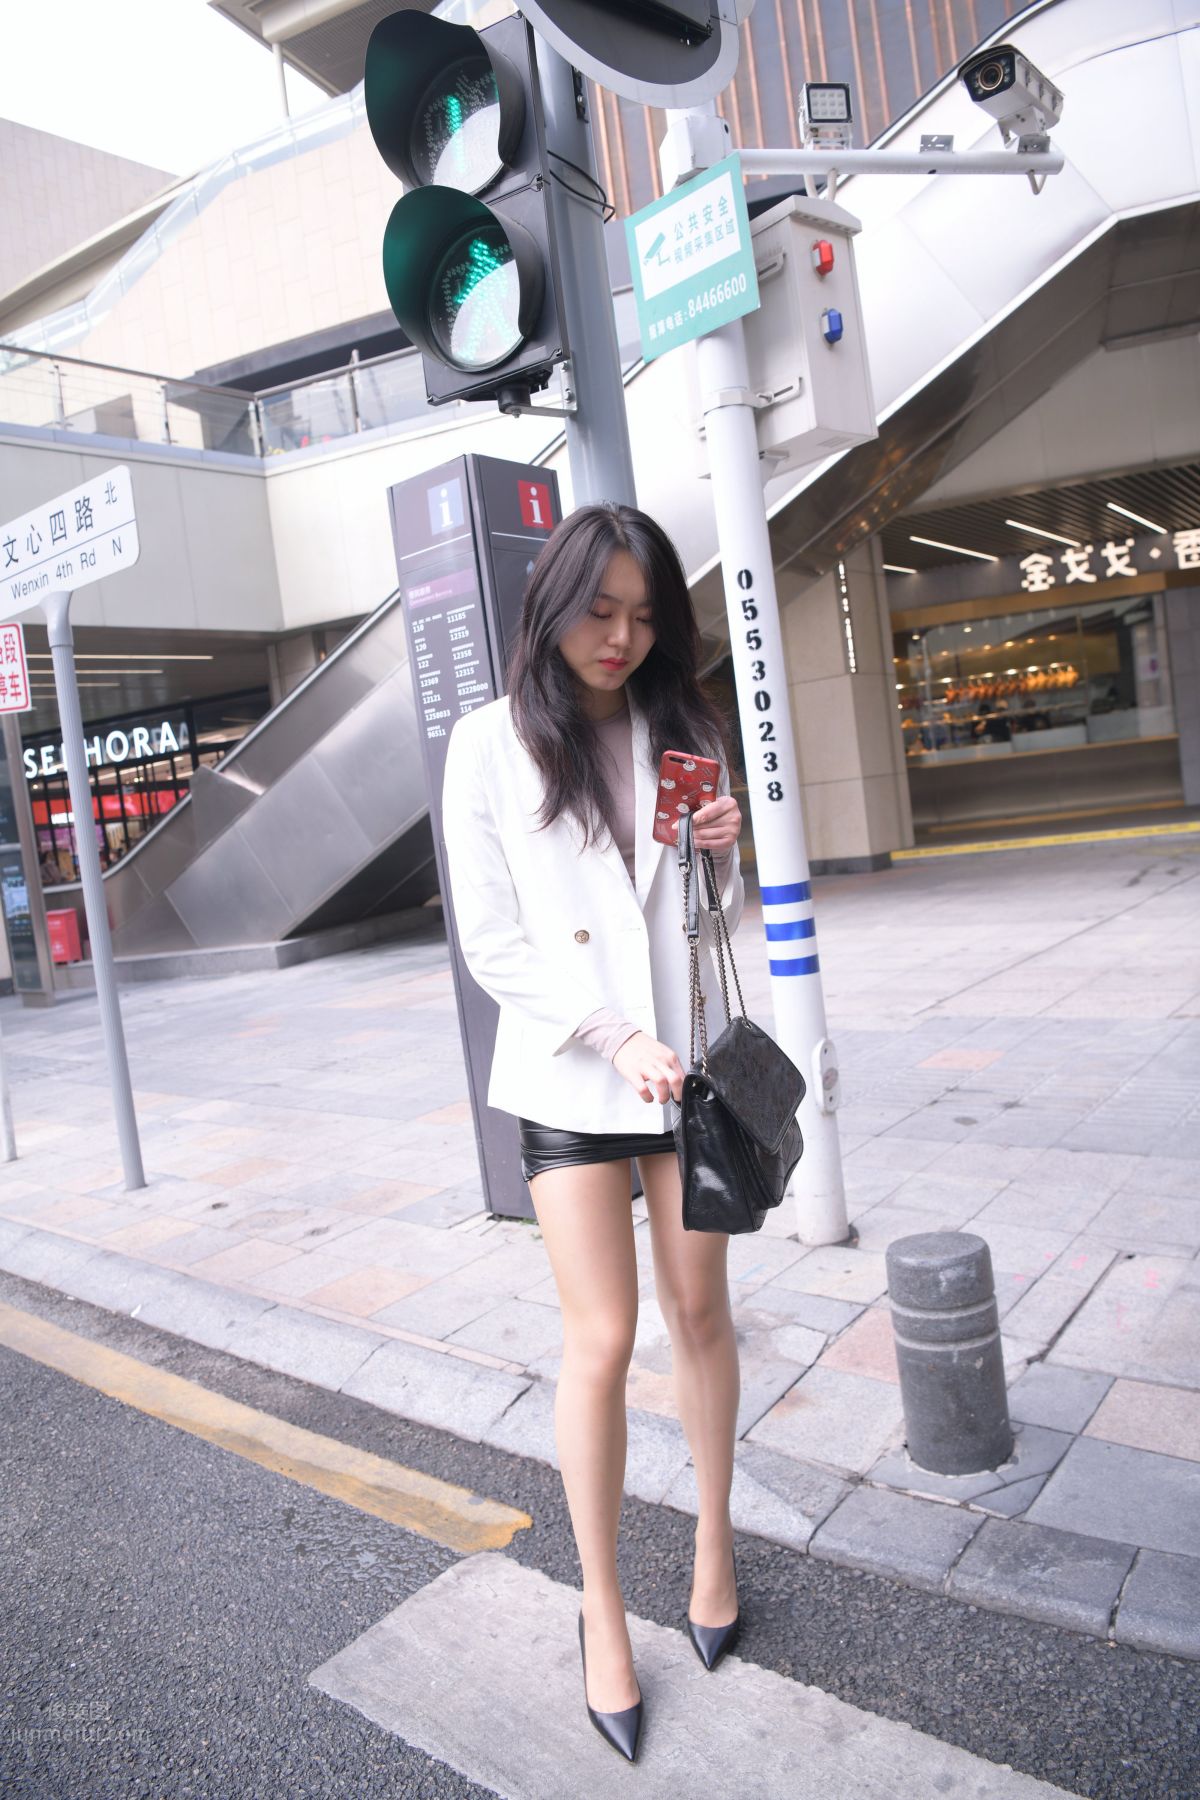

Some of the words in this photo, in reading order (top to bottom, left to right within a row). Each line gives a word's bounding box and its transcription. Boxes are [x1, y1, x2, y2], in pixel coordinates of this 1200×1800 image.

[674, 195, 729, 241] 公共安全
[2, 495, 95, 568] 文心四路
[104, 480, 118, 506] 北
[10, 572, 50, 601] Wenxin
[55, 560, 74, 580] 4th
[79, 547, 97, 570] Rd
[111, 535, 122, 557] N
[0, 632, 18, 665] 段
[449, 629, 470, 642] 12319
[455, 666, 475, 679] 12315
[736, 568, 784, 803] 05530238
[460, 704, 473, 714] 114
[23, 721, 180, 780] SEHORA
